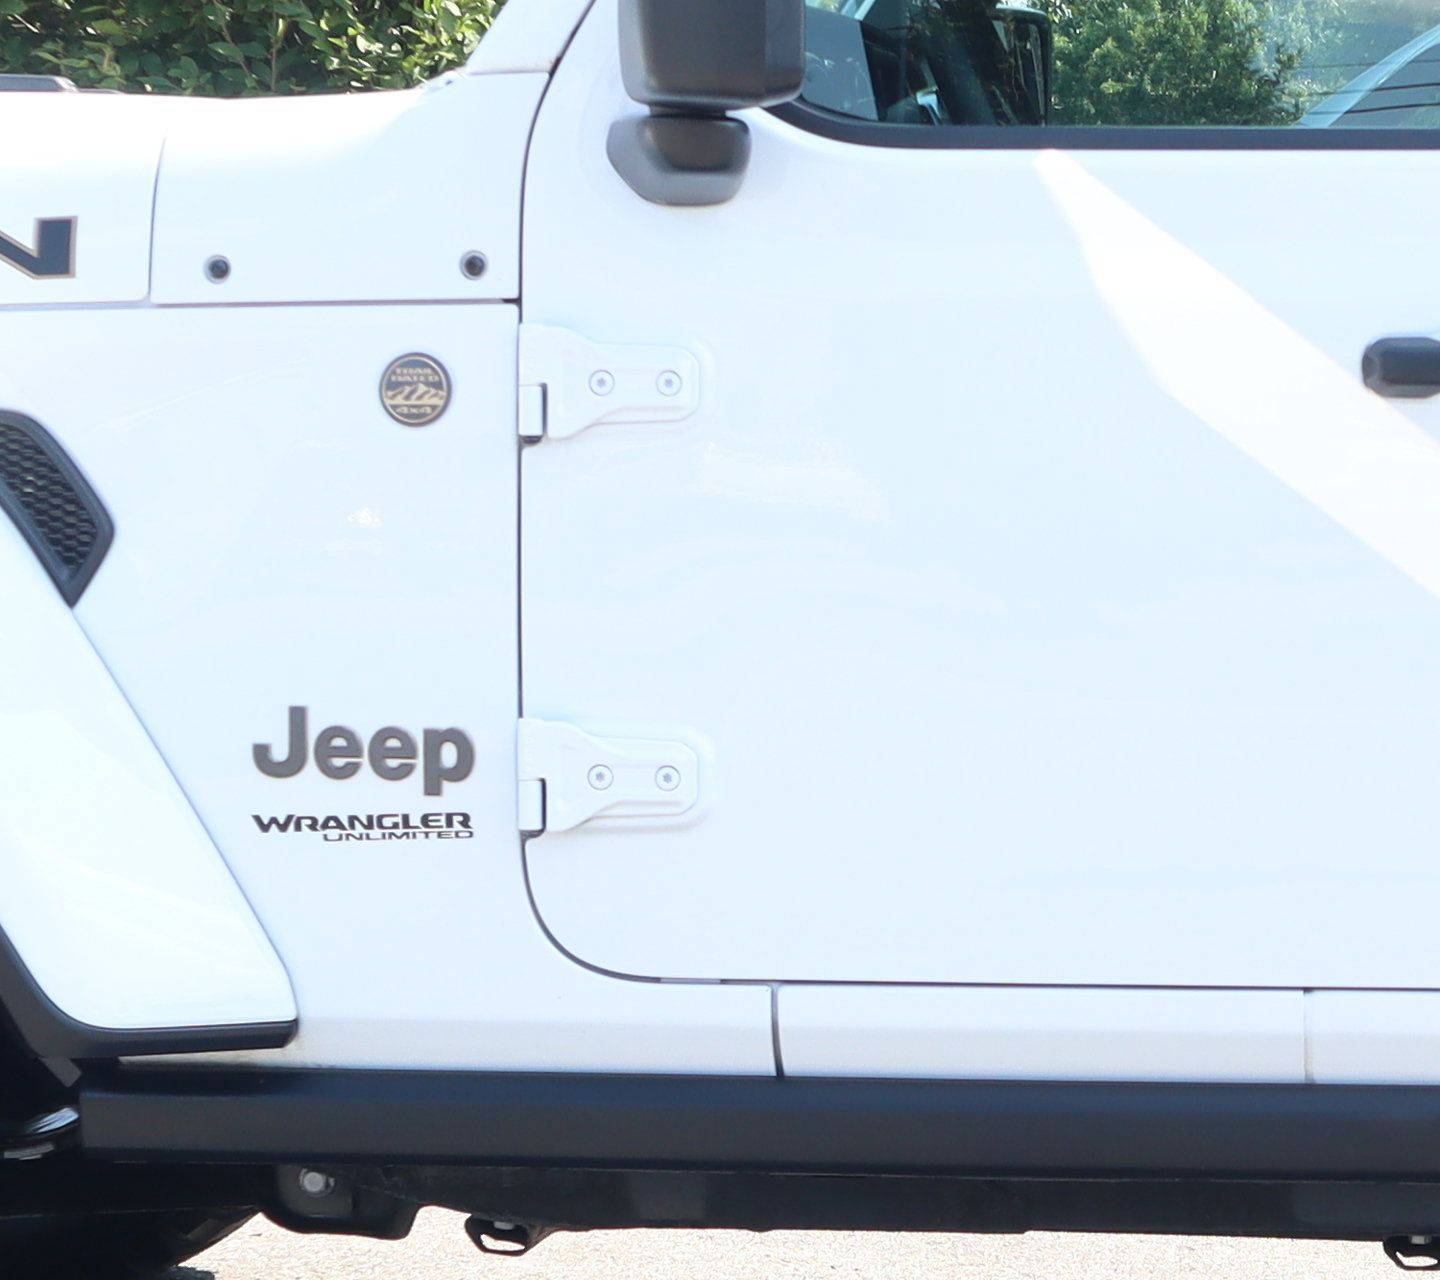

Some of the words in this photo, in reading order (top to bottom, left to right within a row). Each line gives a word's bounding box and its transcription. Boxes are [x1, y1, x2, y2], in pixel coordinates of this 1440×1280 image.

[252, 705, 475, 796] Jeep
[251, 812, 473, 833] WRANGLER
[323, 830, 474, 842] UNLIMITED
